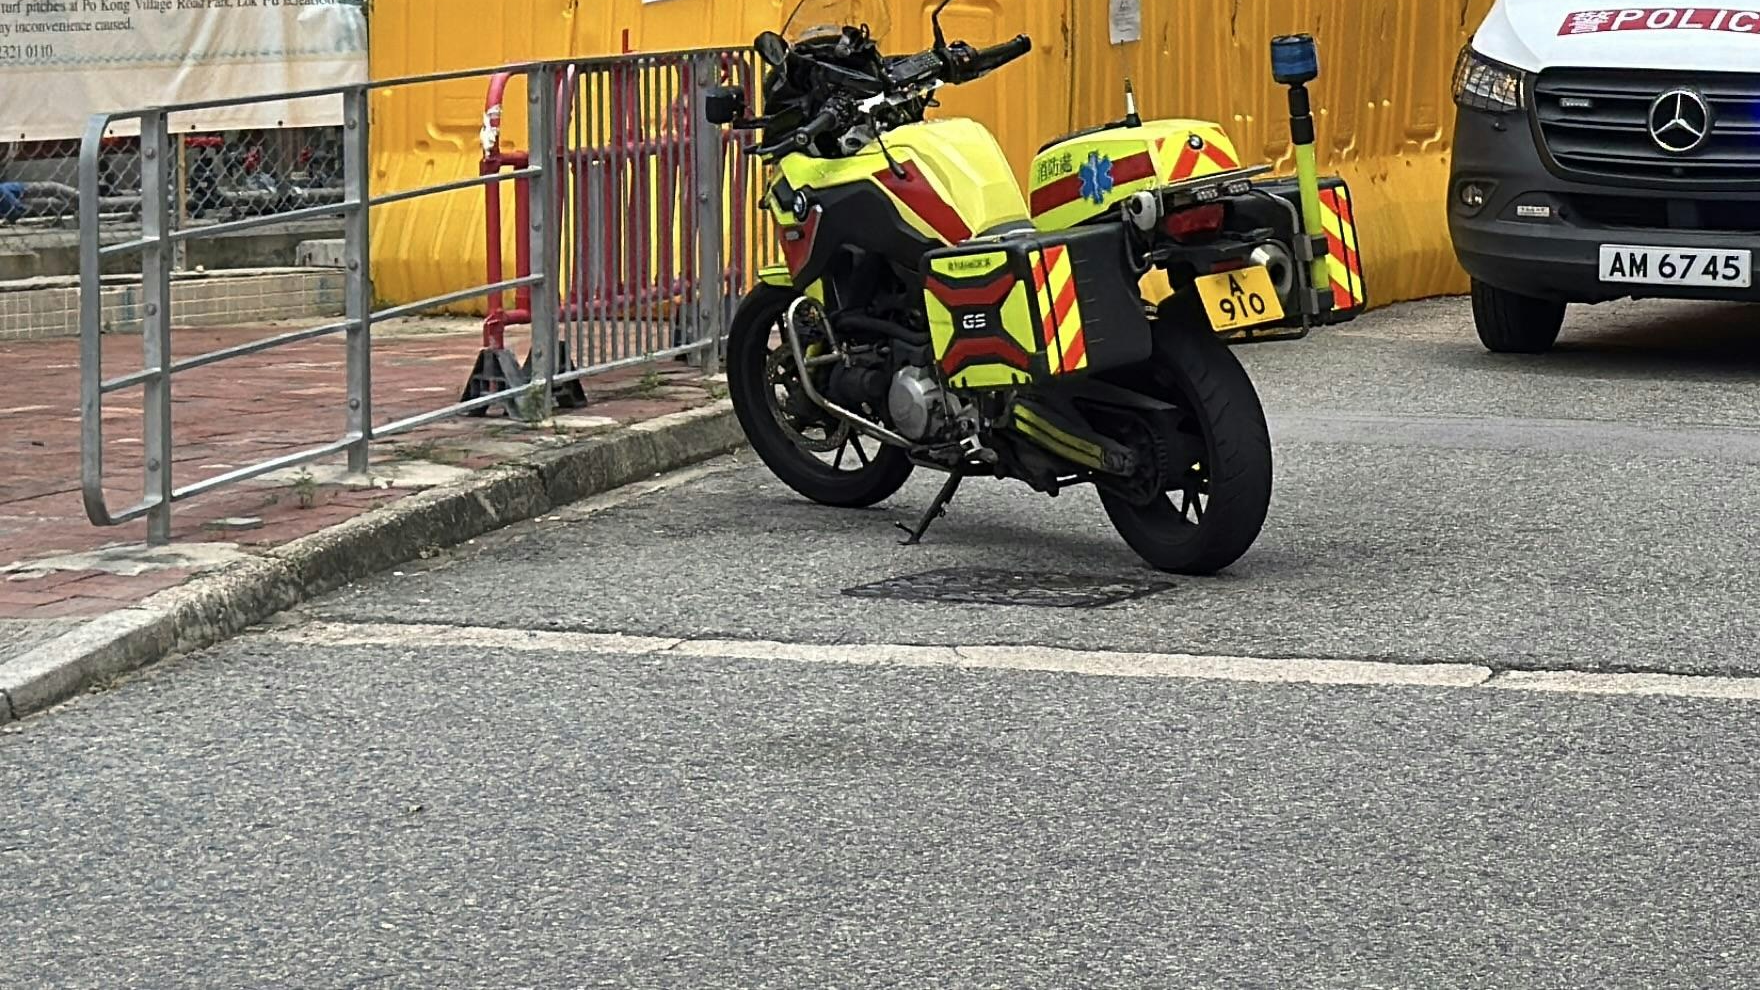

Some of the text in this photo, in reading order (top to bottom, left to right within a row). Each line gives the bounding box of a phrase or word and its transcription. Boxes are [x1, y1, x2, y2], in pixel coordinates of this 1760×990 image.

[1568, 11, 1614, 34] 警
[0, 44, 21, 59] 321
[1609, 252, 1741, 281] AM 6745
[1228, 274, 1245, 297] A
[1219, 293, 1265, 321] 910
[962, 313, 986, 329] GS
